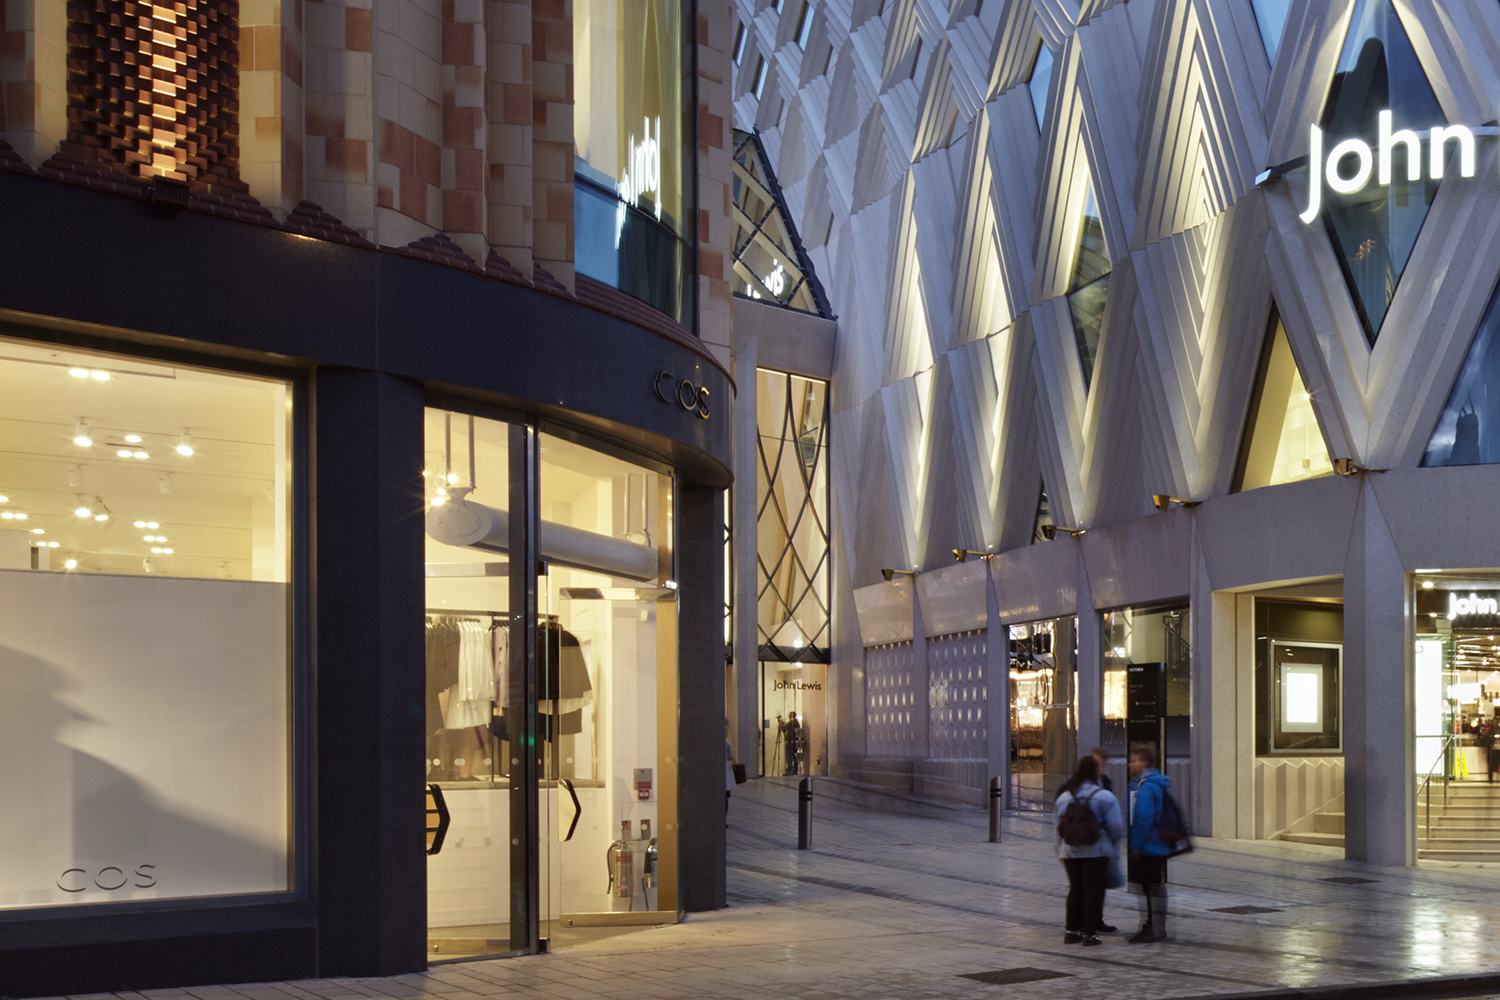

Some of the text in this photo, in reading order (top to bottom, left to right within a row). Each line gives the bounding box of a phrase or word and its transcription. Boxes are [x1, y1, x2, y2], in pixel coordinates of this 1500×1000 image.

[1299, 109, 1475, 224] John
[654, 370, 710, 419] COS
[1447, 592, 1497, 620] John
[773, 679, 822, 691] John Lewis
[56, 864, 157, 893] COS
